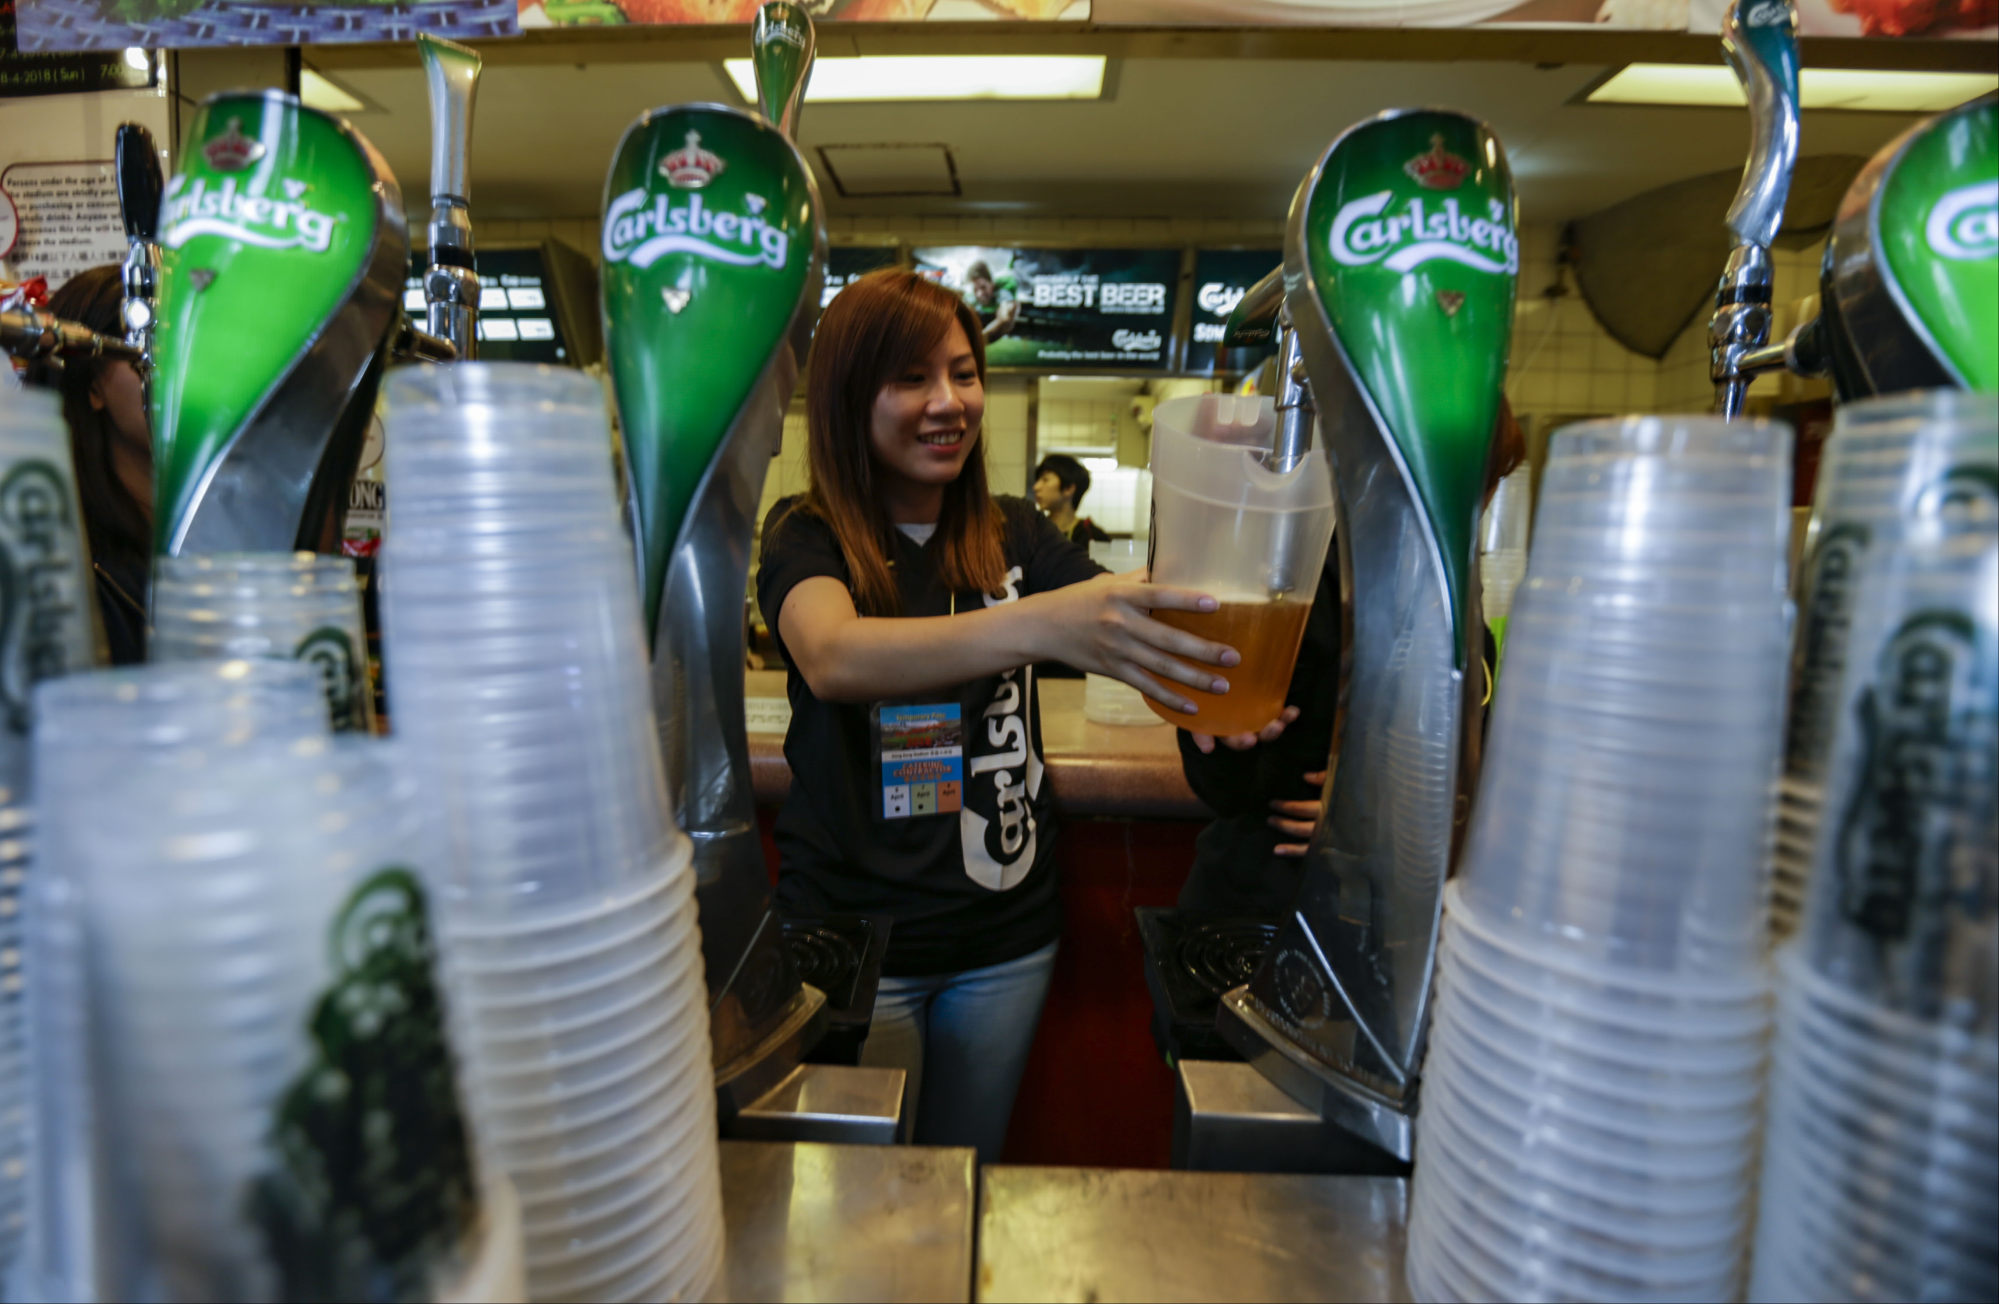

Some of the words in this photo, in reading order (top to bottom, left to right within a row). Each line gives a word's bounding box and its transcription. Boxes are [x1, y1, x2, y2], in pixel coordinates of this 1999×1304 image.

[7, 178, 38, 187] Persons
[40, 177, 62, 186] under
[65, 176, 78, 184] the
[80, 178, 96, 187] age
[98, 175, 107, 184] of
[23, 188, 54, 198] stadium
[56, 189, 69, 197] are
[72, 187, 98, 197] strictly
[29, 201, 73, 211] purchasing
[601, 187, 789, 270] Carlsberg
[44, 237, 56, 246] the
[1034, 283, 1098, 308] BEST
[1100, 283, 1166, 307] BEER
